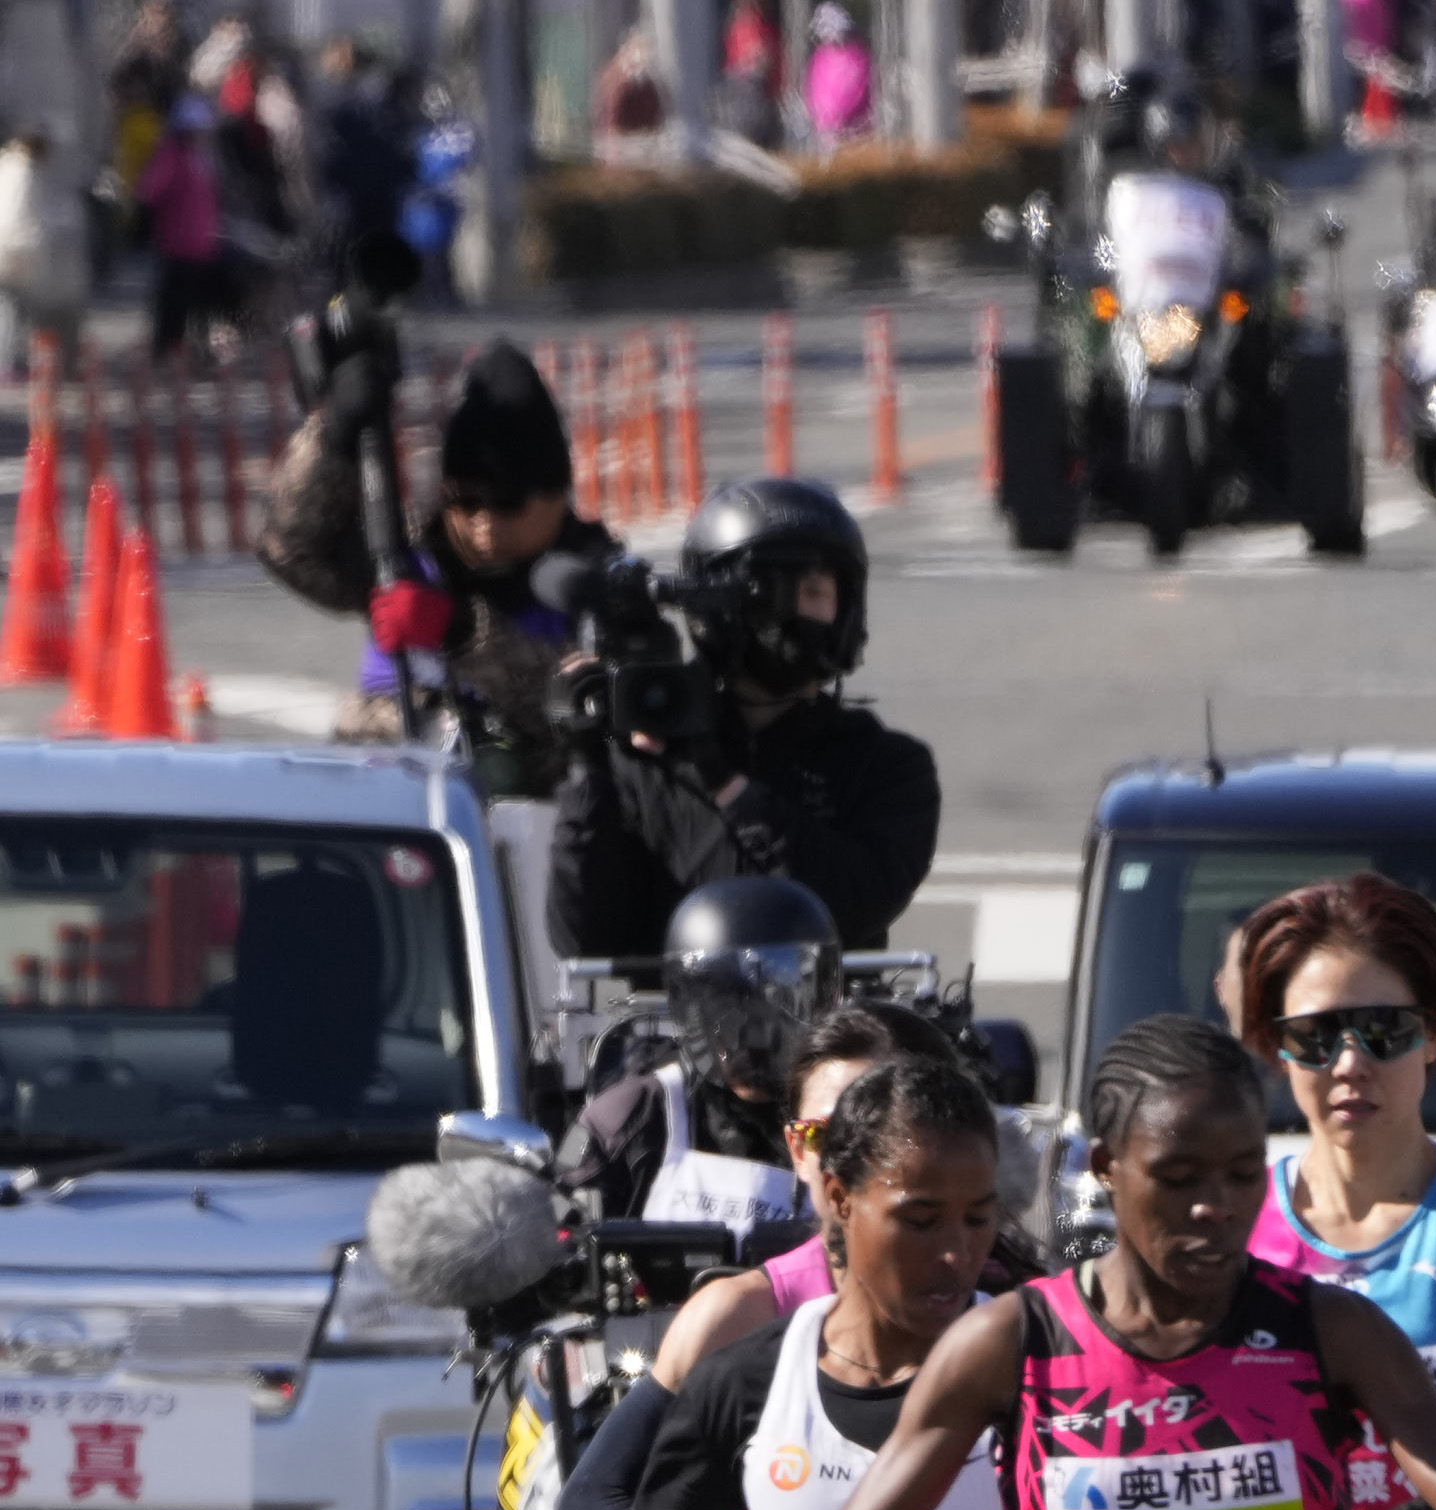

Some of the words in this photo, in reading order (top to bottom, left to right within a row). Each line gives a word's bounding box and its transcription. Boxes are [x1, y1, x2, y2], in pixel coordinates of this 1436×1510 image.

[819, 1463, 852, 1481] NN
[1117, 1451, 1284, 1510] 奥村組
